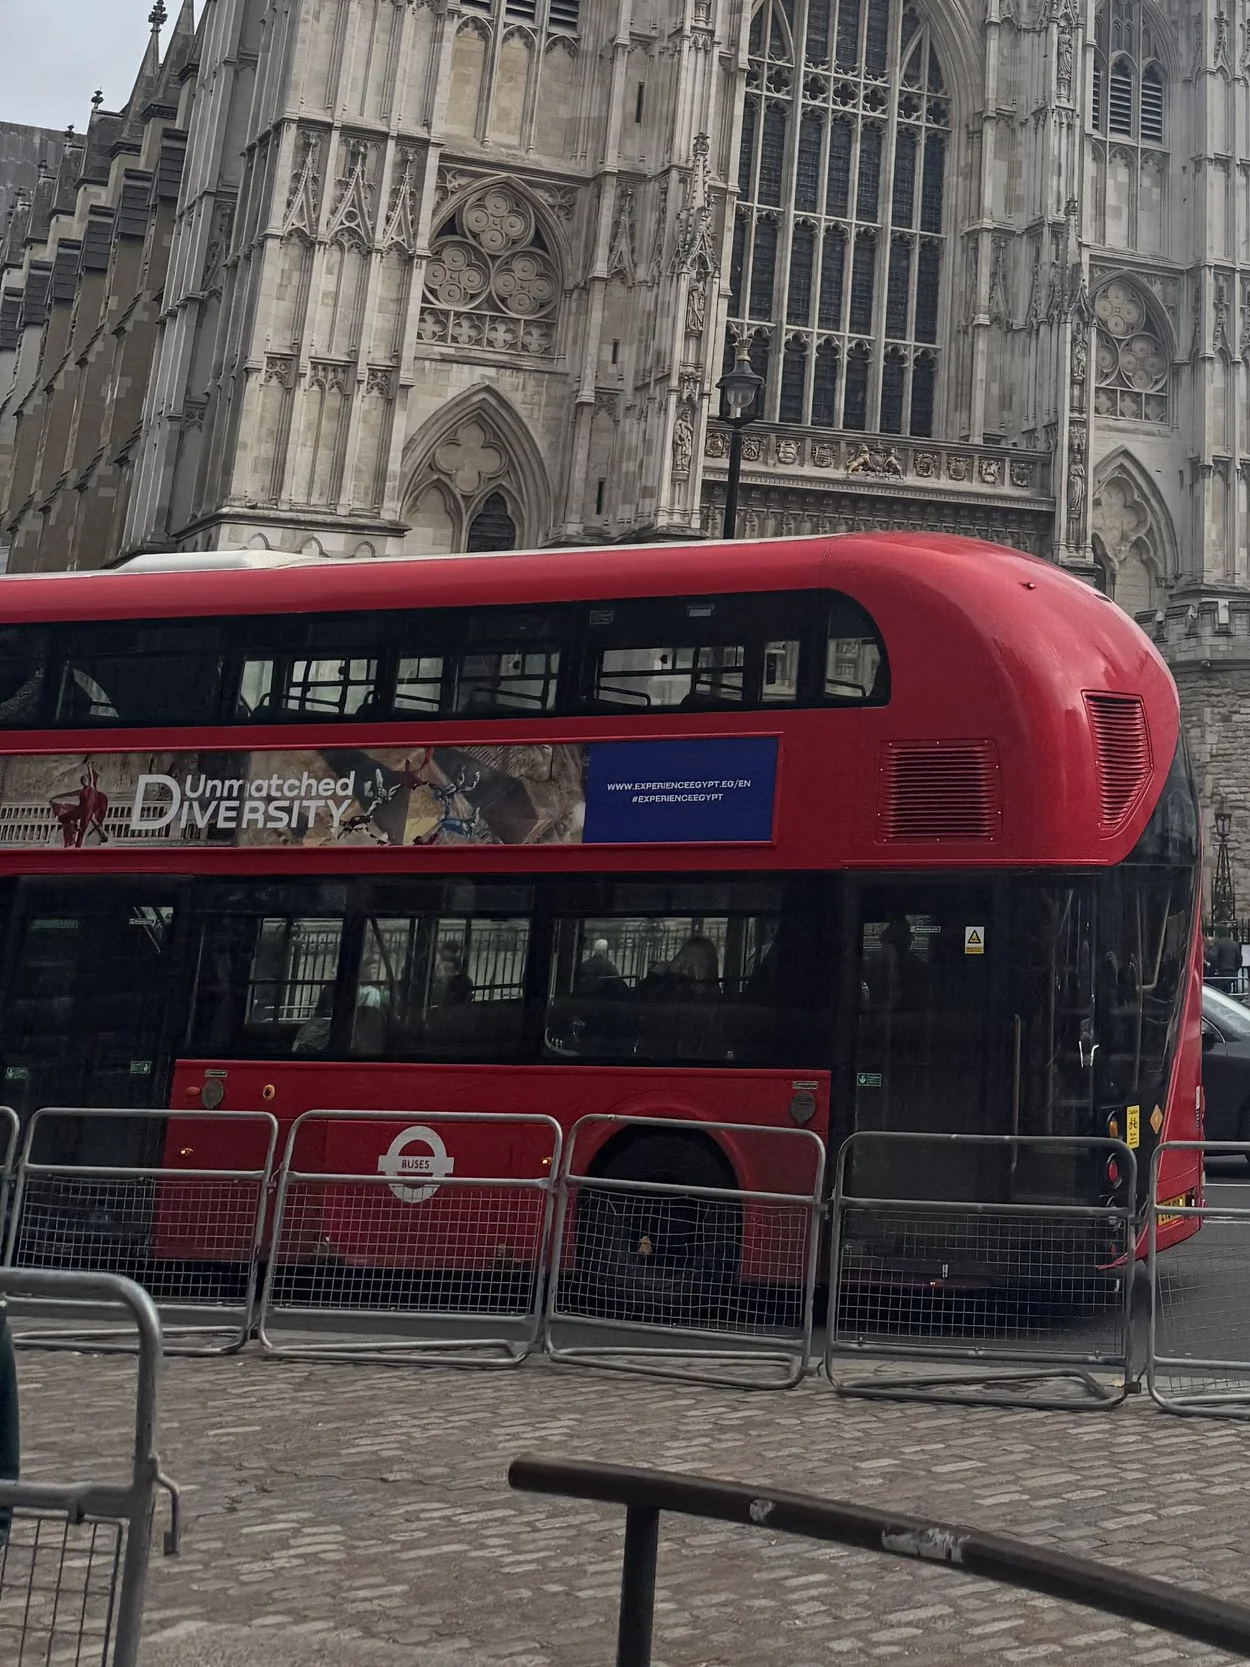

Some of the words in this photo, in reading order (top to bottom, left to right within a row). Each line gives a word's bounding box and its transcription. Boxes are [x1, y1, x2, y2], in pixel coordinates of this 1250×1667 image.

[184, 770, 355, 798] Unmatched
[607, 779, 751, 791] WWW.EXPERIENCEEGYPT.EG/EN
[130, 774, 352, 830] DIVERSITY
[631, 793, 724, 803] #EXPERIENCEEGYPT
[401, 1159, 430, 1170] BUSES
